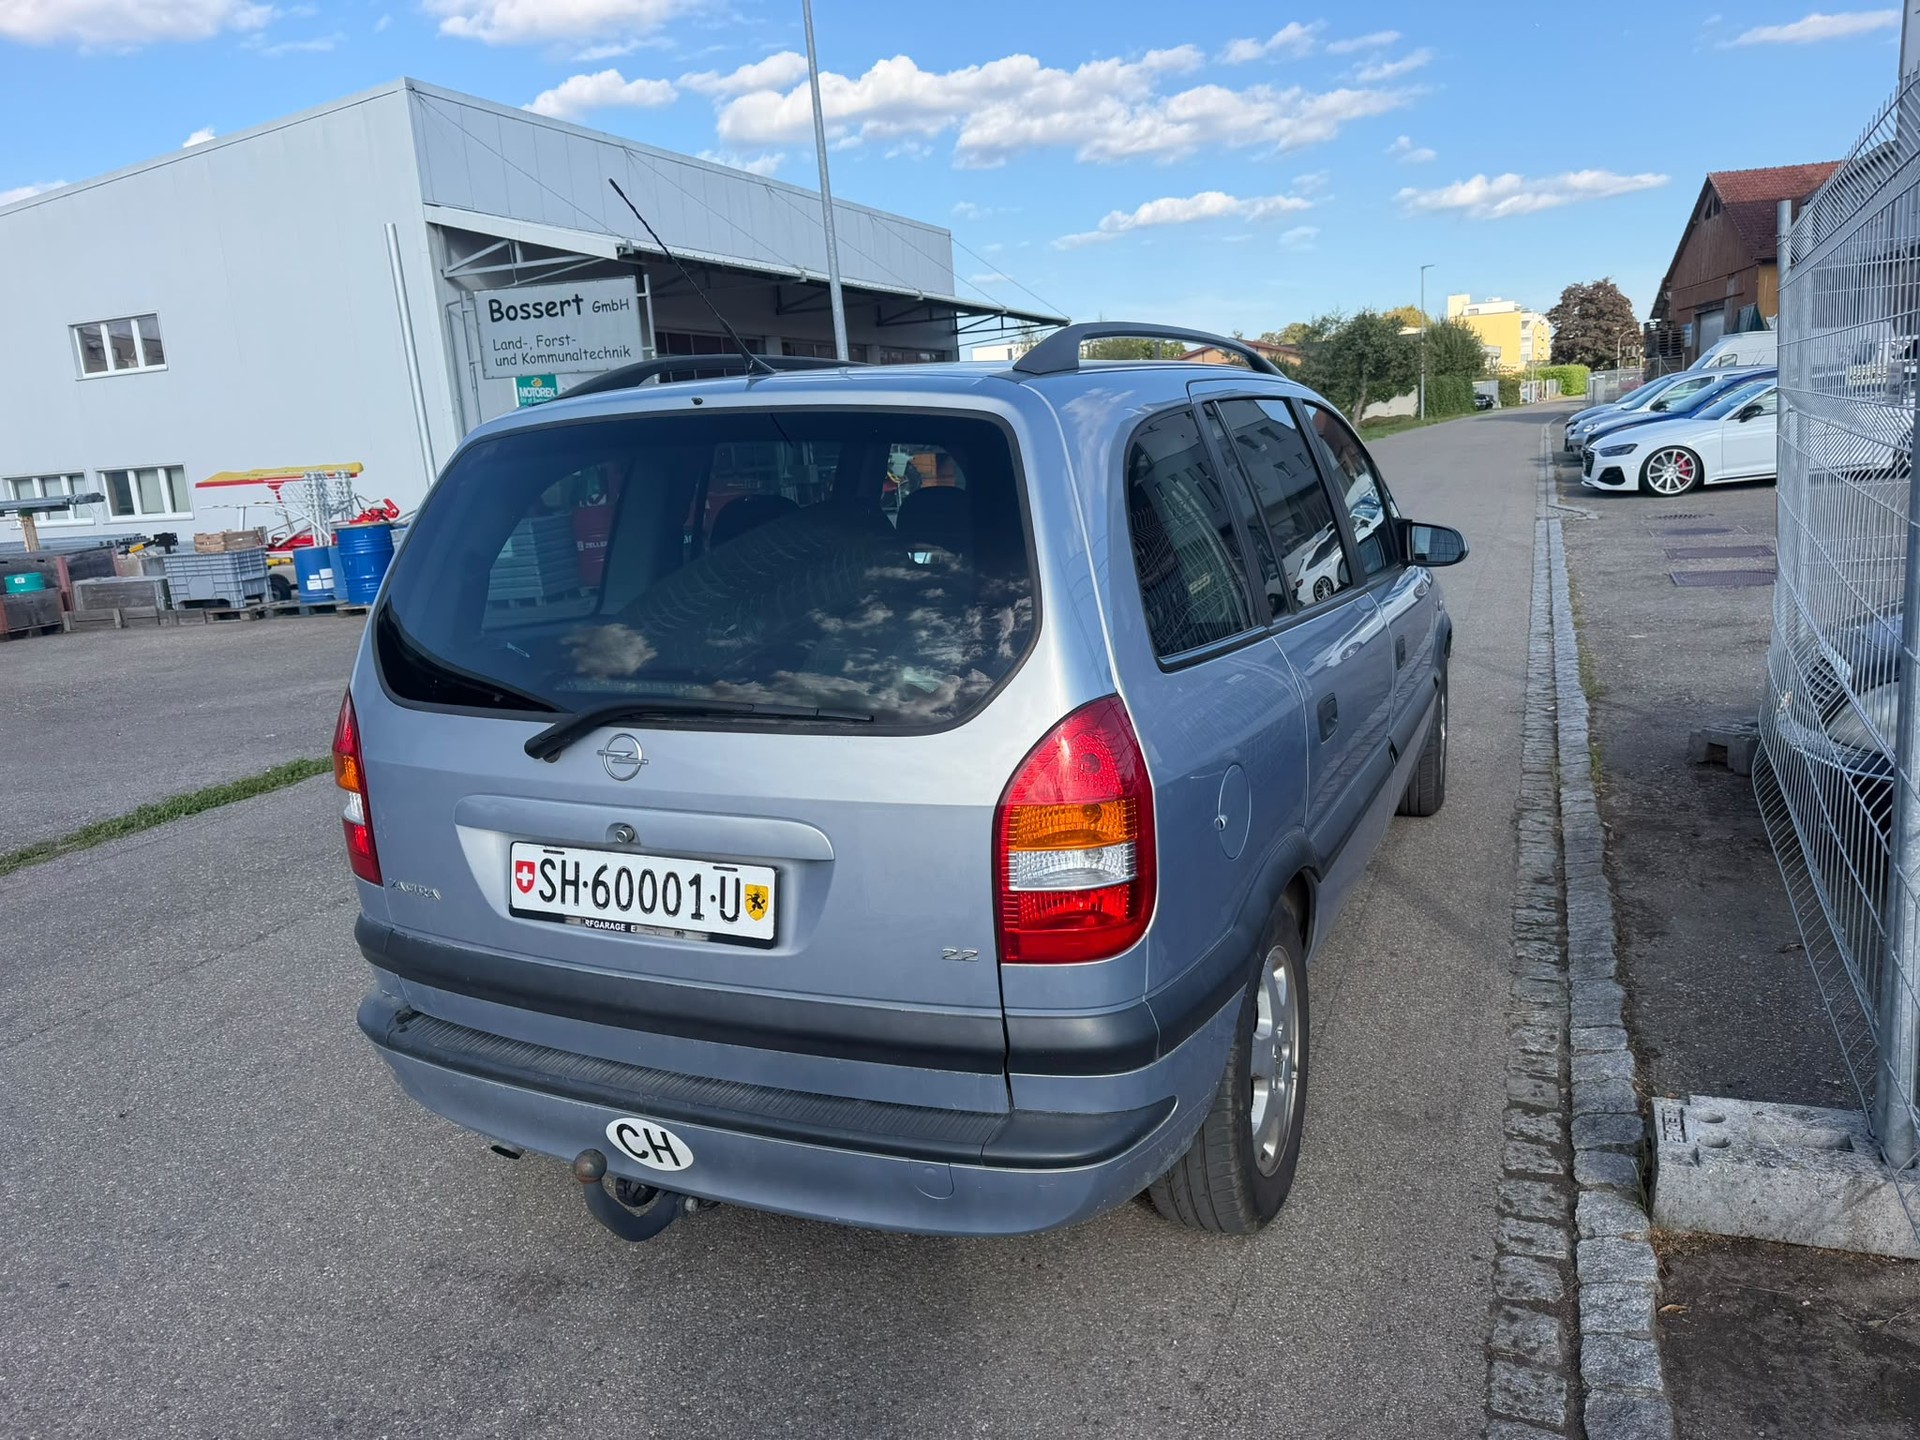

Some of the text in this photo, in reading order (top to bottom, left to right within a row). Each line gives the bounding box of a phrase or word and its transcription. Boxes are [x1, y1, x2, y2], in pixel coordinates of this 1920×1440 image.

[488, 293, 630, 323] Bossert GmbH
[536, 334, 577, 348] Forst-
[495, 345, 632, 367] und Kommunaltechnik
[519, 387, 556, 398] MOTOREX
[616, 1123, 681, 1167] CH
